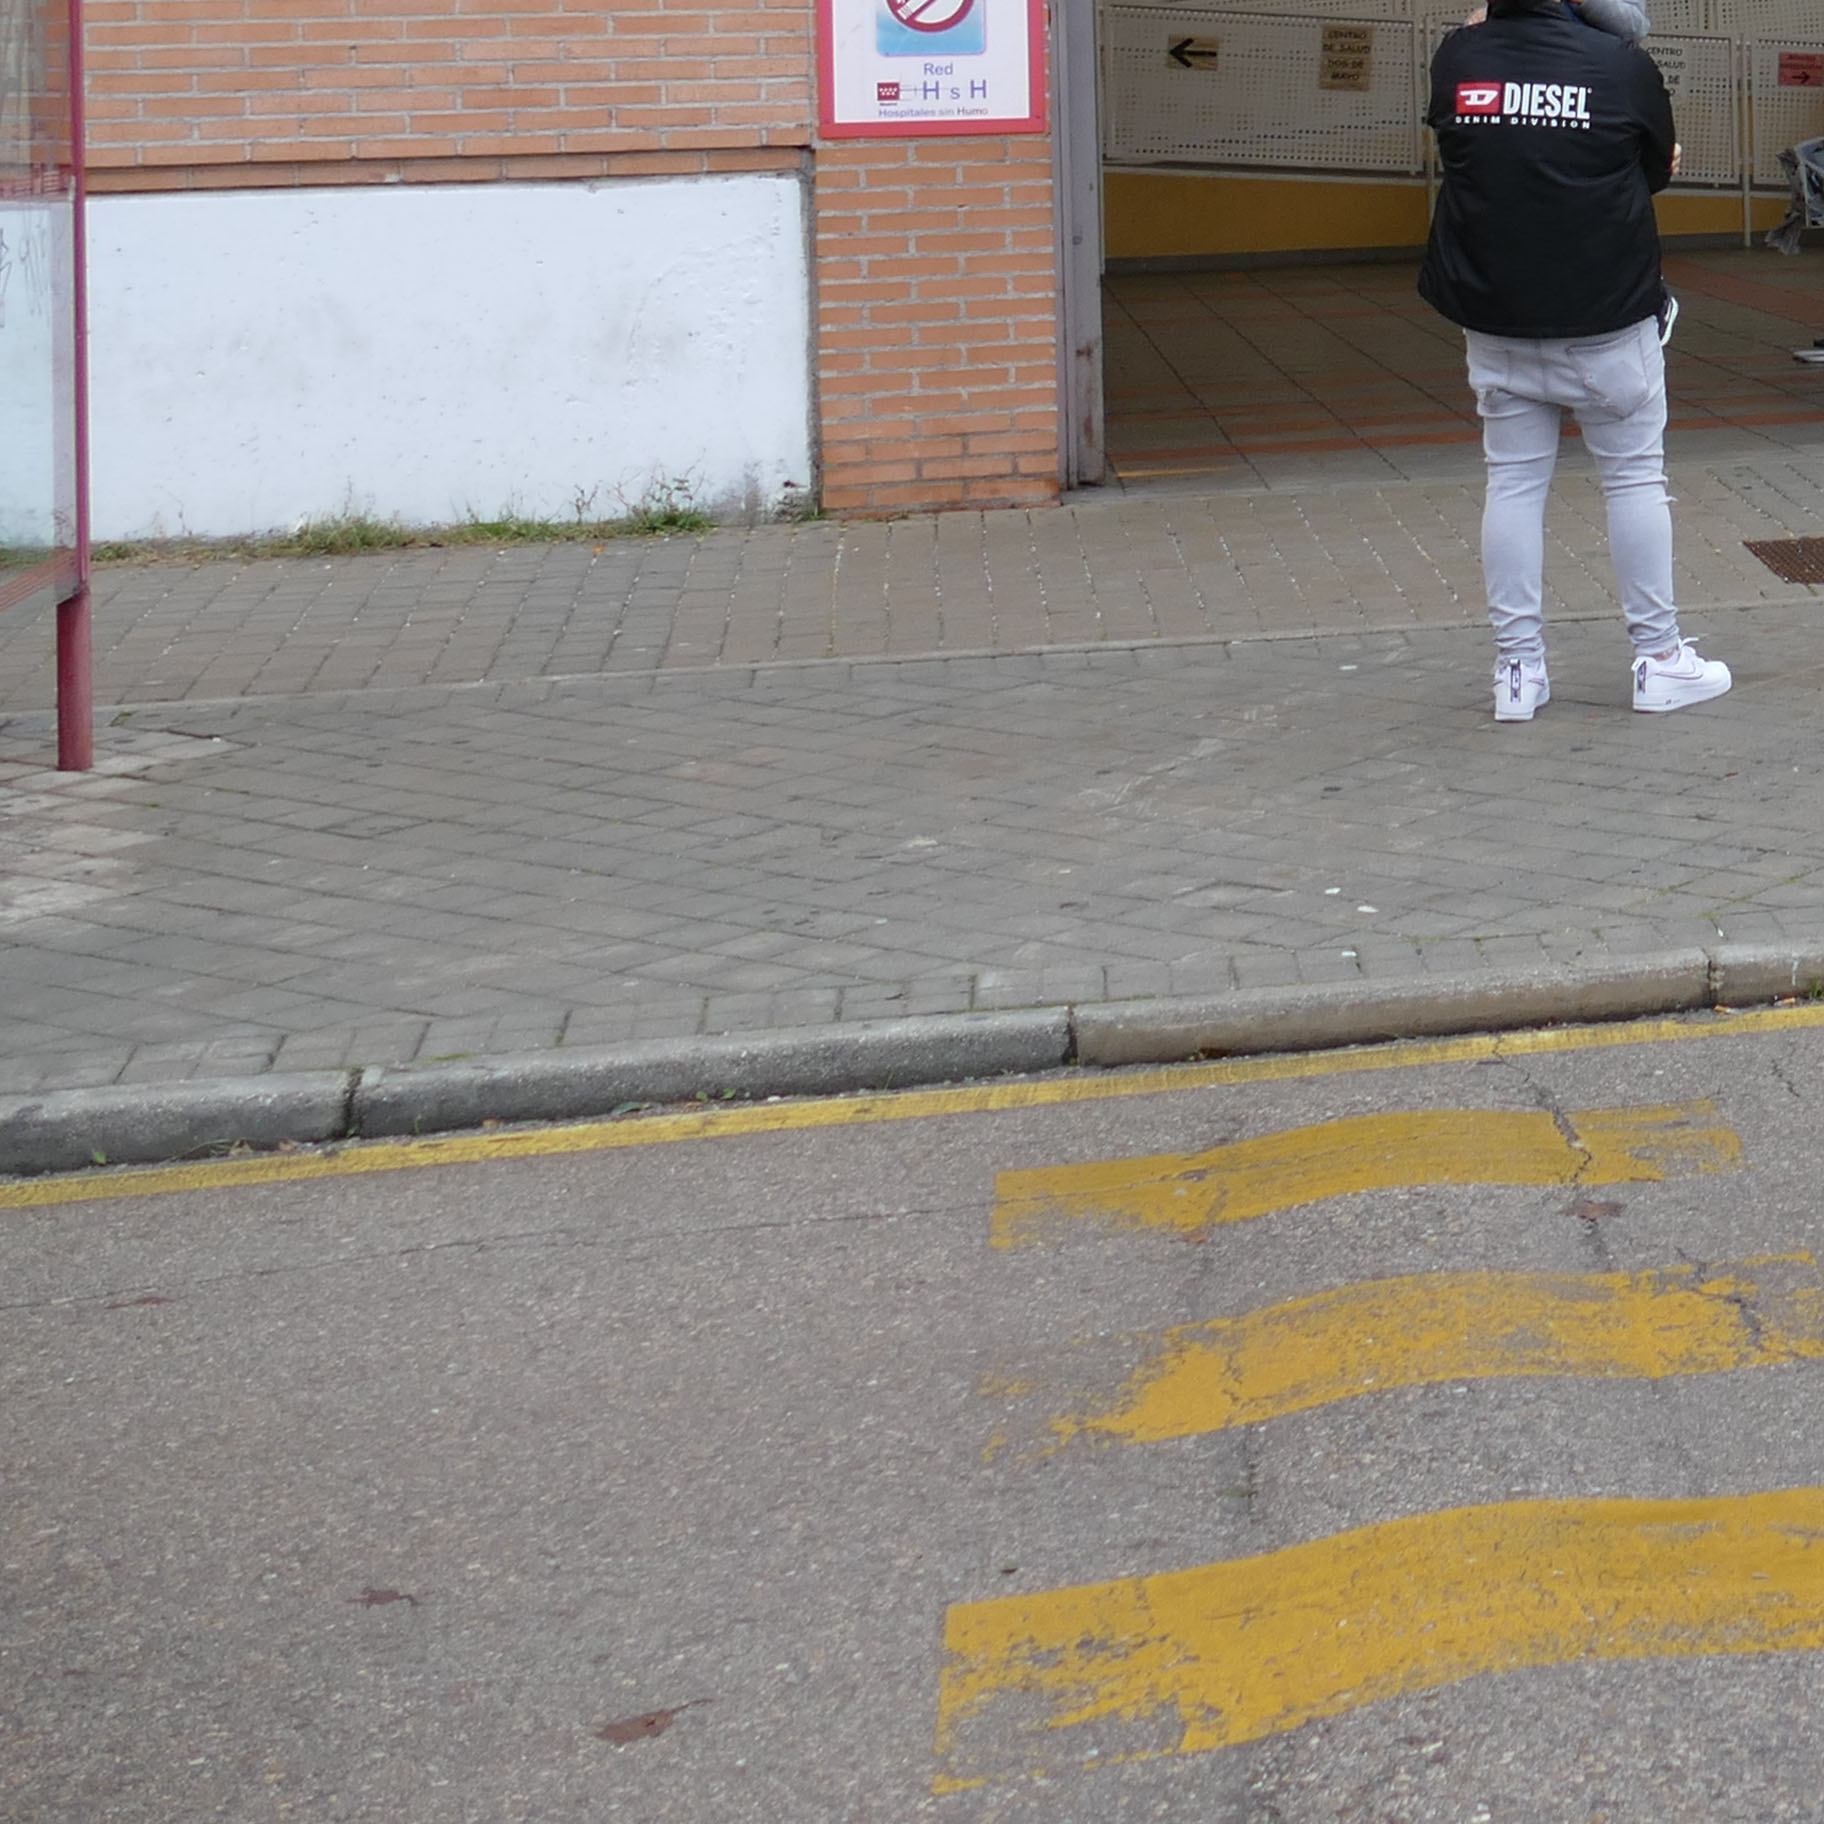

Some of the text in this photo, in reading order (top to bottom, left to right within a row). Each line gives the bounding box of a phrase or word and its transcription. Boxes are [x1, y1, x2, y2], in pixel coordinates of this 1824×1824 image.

[924, 62, 953, 76] Red
[1503, 82, 1590, 120] DIESEL
[879, 107, 989, 118] Hospitales sin Humo
[1455, 116, 1590, 129] DENIM DIVISION
